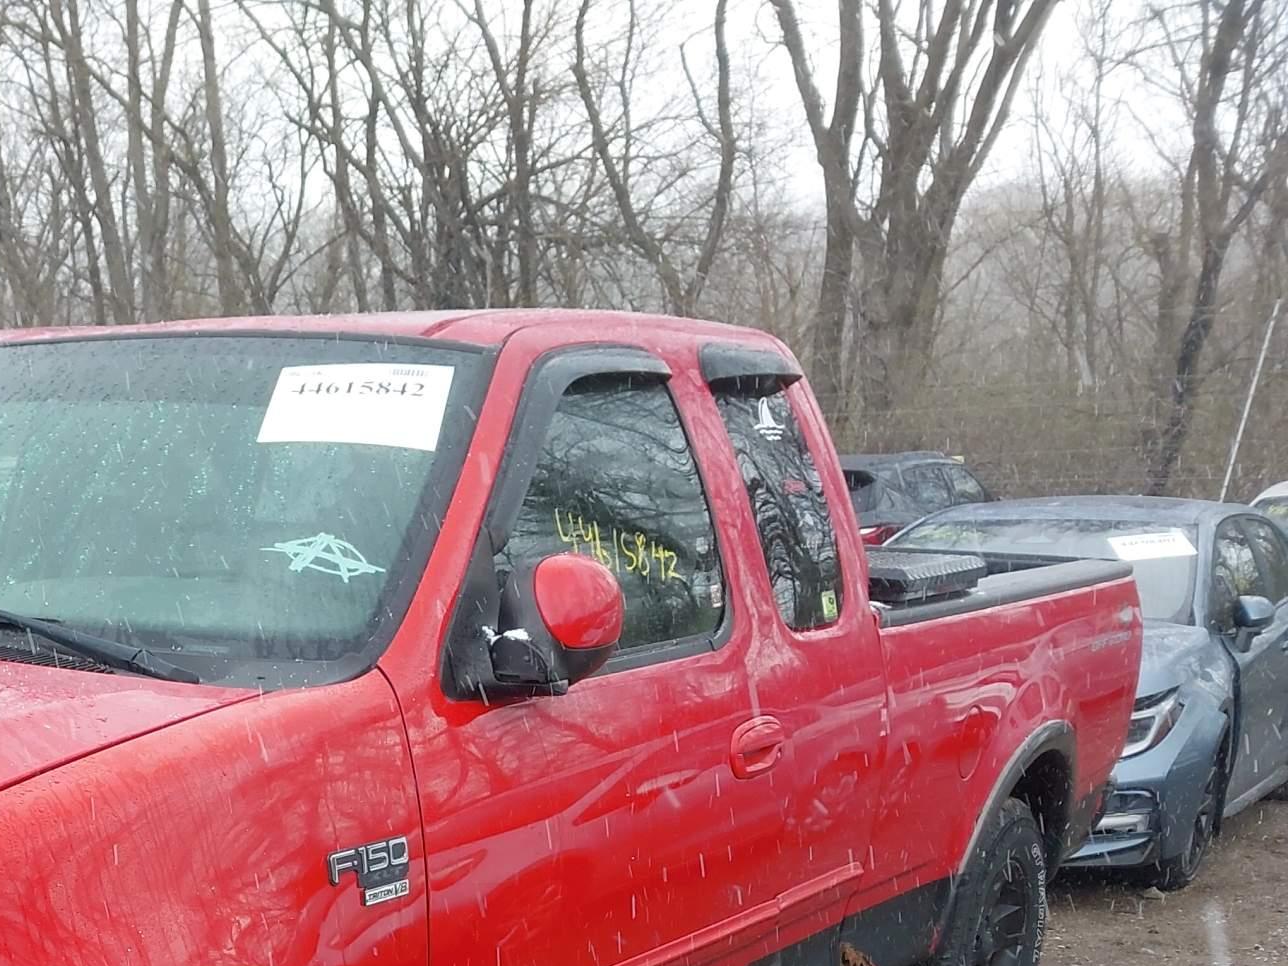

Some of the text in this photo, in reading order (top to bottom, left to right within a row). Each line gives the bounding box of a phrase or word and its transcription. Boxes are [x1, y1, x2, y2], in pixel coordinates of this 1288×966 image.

[290, 381, 425, 397] 44615842
[554, 507, 686, 583] 44615842
[367, 882, 408, 901] TRITON V8
